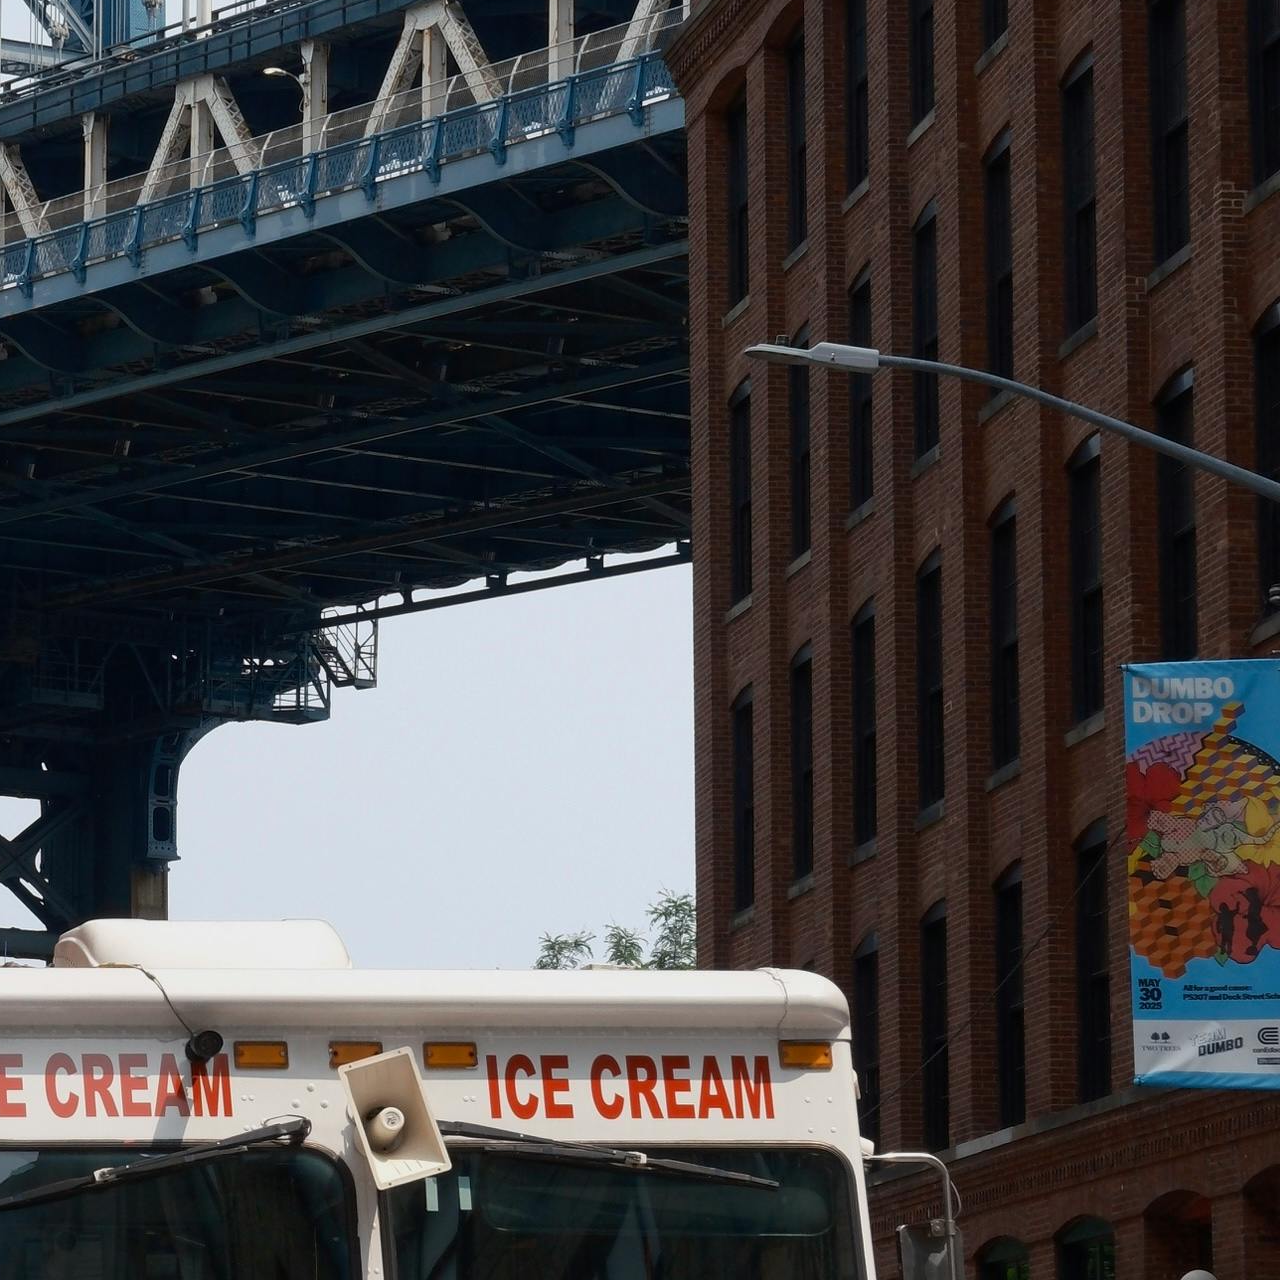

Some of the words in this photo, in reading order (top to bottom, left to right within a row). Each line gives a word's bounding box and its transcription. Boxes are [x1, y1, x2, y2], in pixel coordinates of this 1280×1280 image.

[1132, 677, 1234, 699] DUMBO
[1133, 701, 1214, 724] DROP
[1138, 978, 1161, 987] MAY
[1140, 988, 1162, 1001] 30
[1140, 1002, 1162, 1010] 2025
[1199, 1037, 1244, 1057] DUMBO
[45, 1052, 233, 1119] CREAM
[486, 1054, 574, 1120] ICE
[590, 1054, 775, 1120] CREAM
